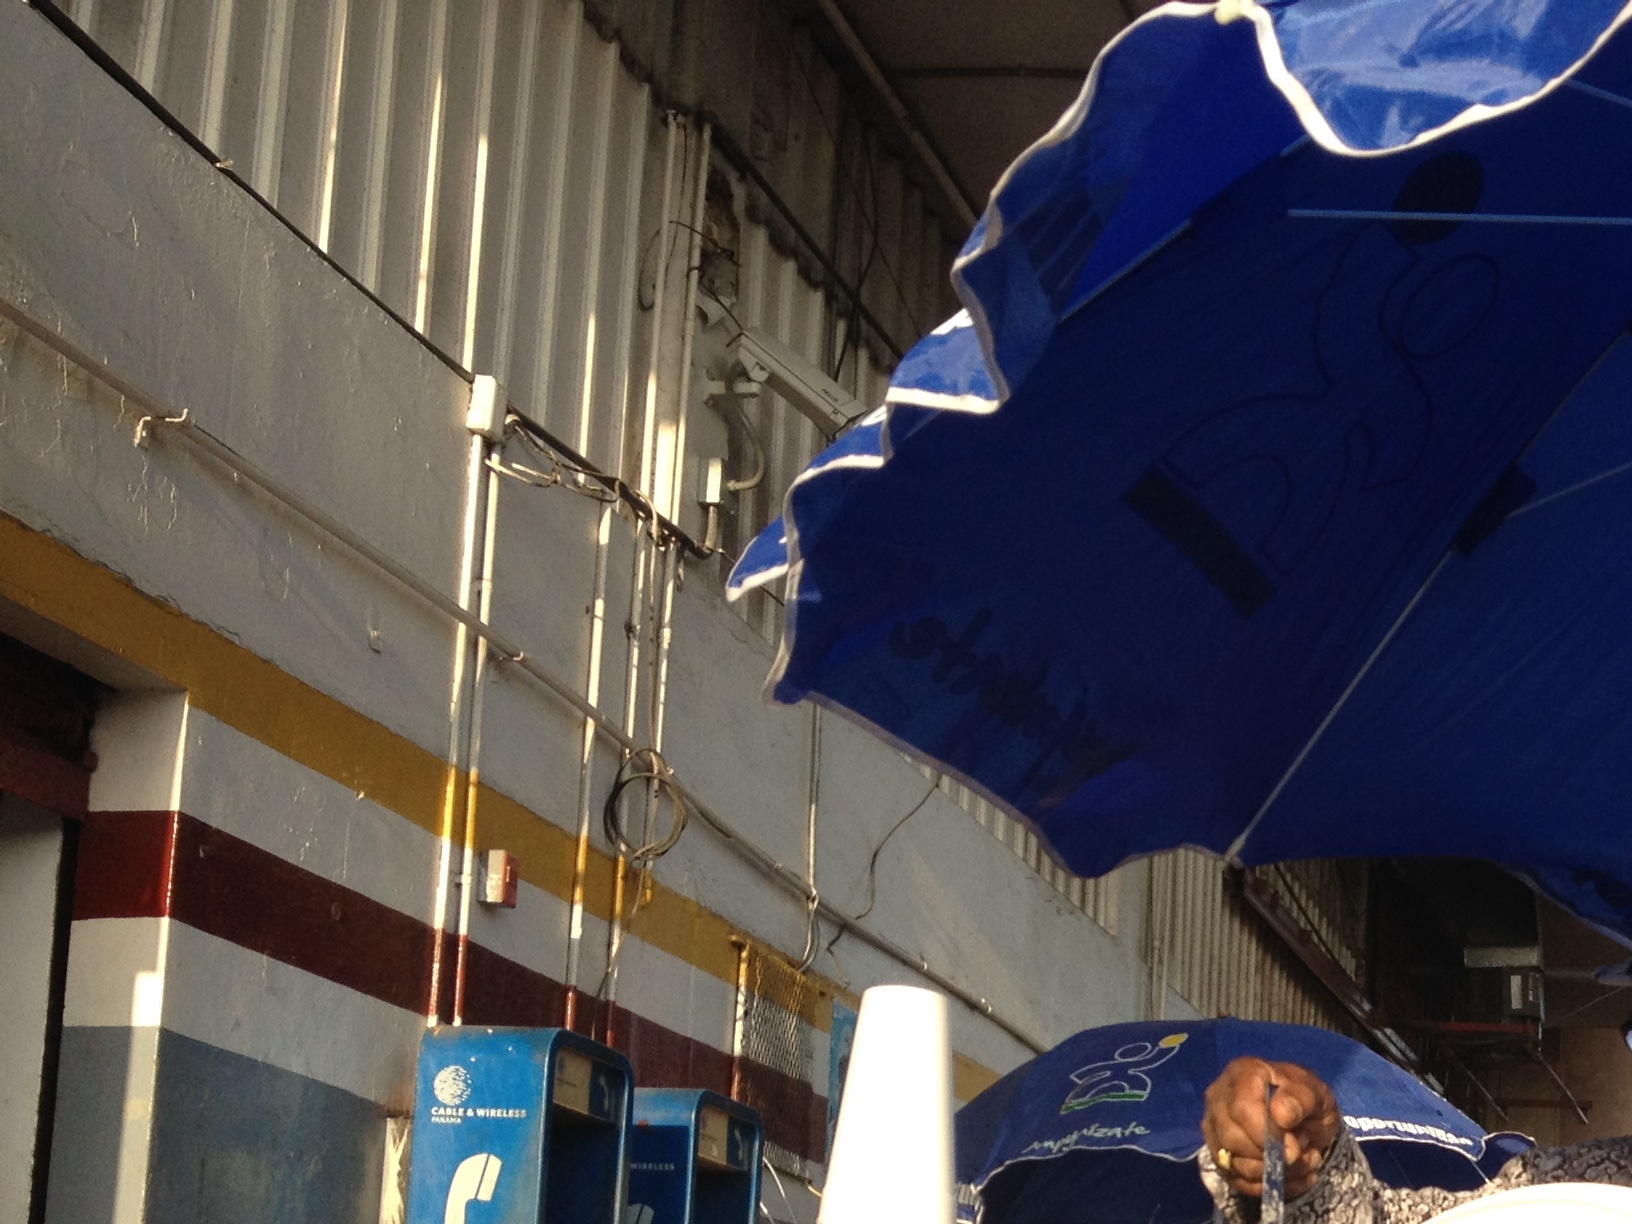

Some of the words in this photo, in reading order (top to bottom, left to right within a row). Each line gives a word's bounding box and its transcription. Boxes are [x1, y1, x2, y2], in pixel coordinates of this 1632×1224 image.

[431, 1107, 465, 1116] CABLE
[466, 1108, 474, 1117] &
[476, 1108, 527, 1118] WIRELESS
[630, 1162, 675, 1171] WIRELESS
